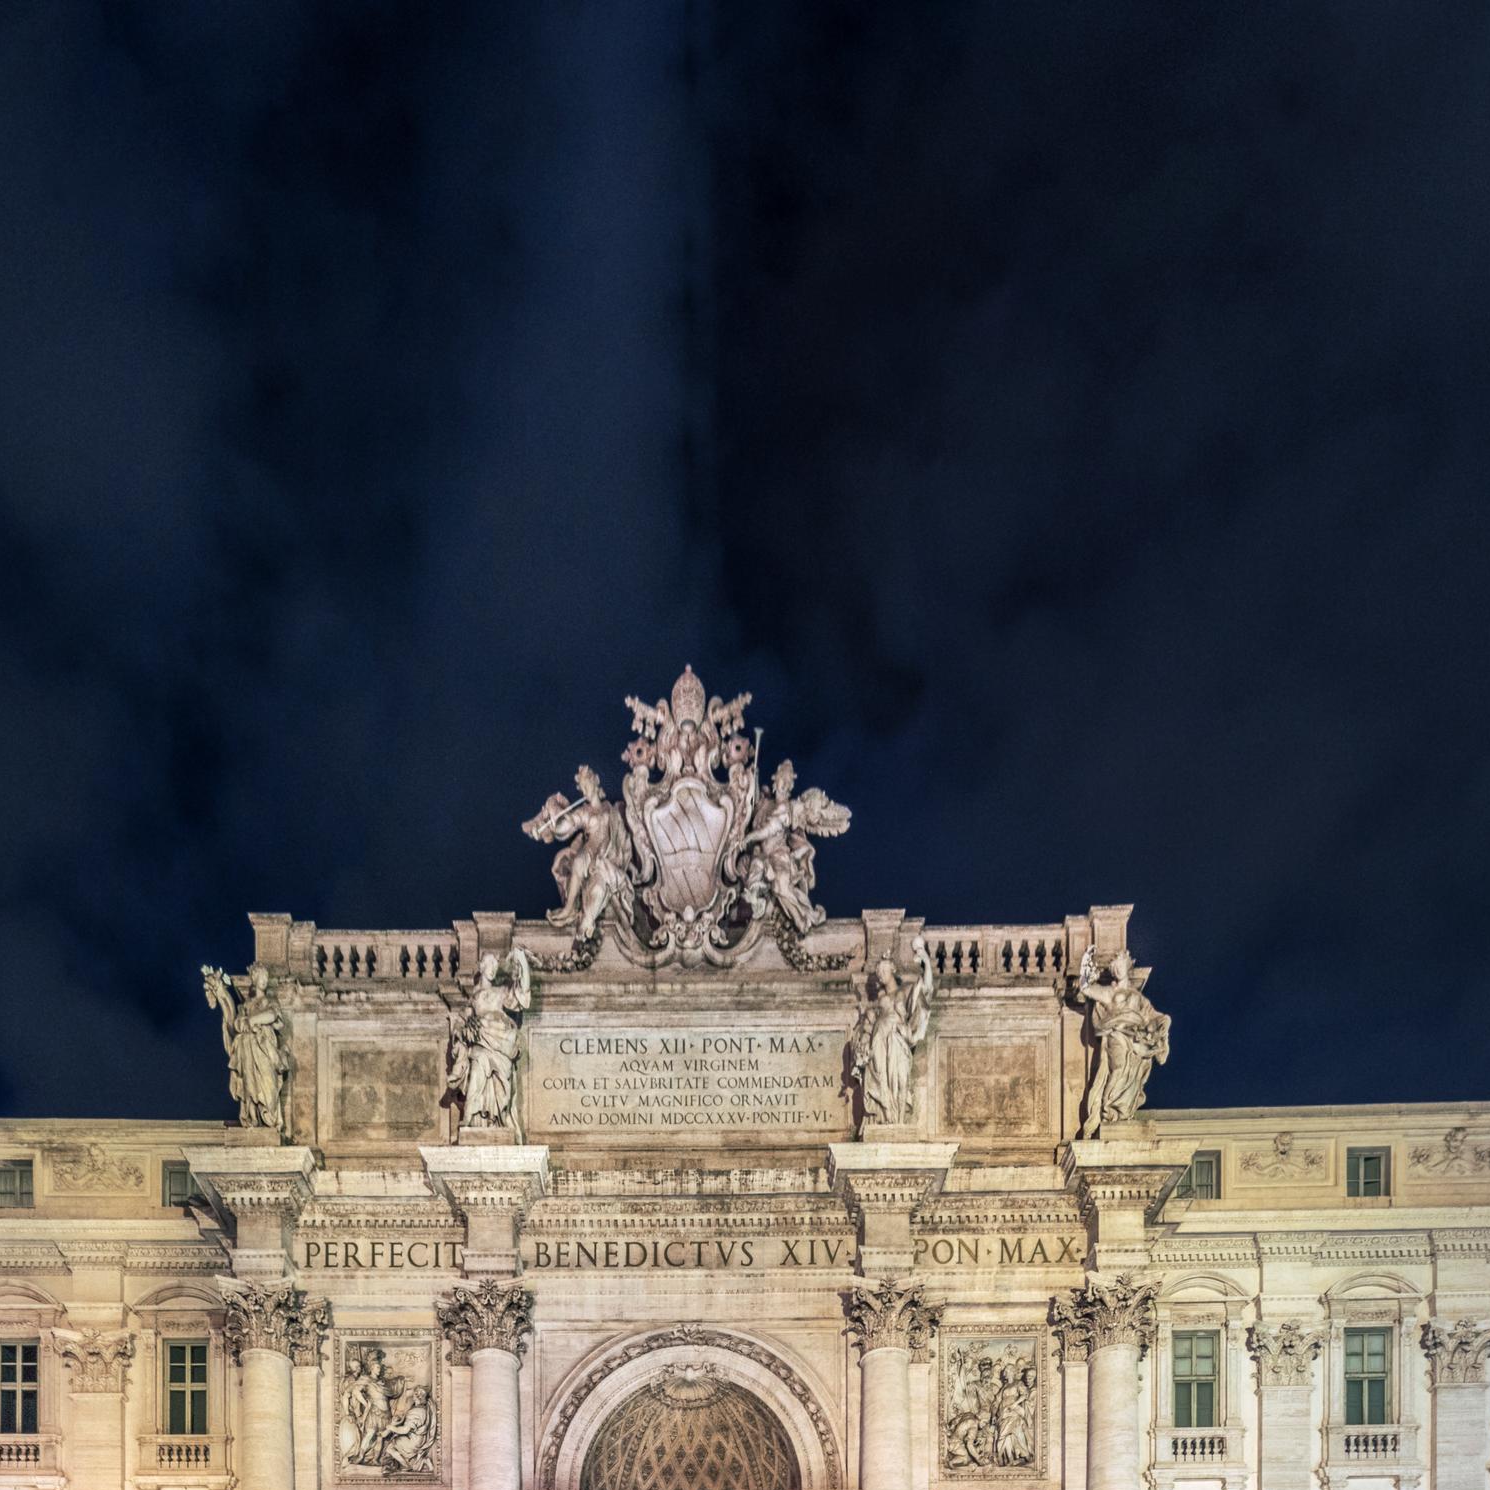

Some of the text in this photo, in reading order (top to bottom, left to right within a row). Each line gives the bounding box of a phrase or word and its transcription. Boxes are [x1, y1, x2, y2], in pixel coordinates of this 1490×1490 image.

[559, 1038, 648, 1055] CLEMENS
[619, 1059, 759, 1075] AQVAM VIRGINEM
[543, 1076, 834, 1090] COPIA ET SALVBRITATE COMMENDATAM
[580, 1094, 799, 1108] CVLTV MAGNIFICO ORNAVIT
[549, 1112, 594, 1125] ANNO
[598, 1112, 653, 1125] DOMINI
[304, 1241, 465, 1269] PERFECIT
[534, 1240, 754, 1269] BENEDICTVS
